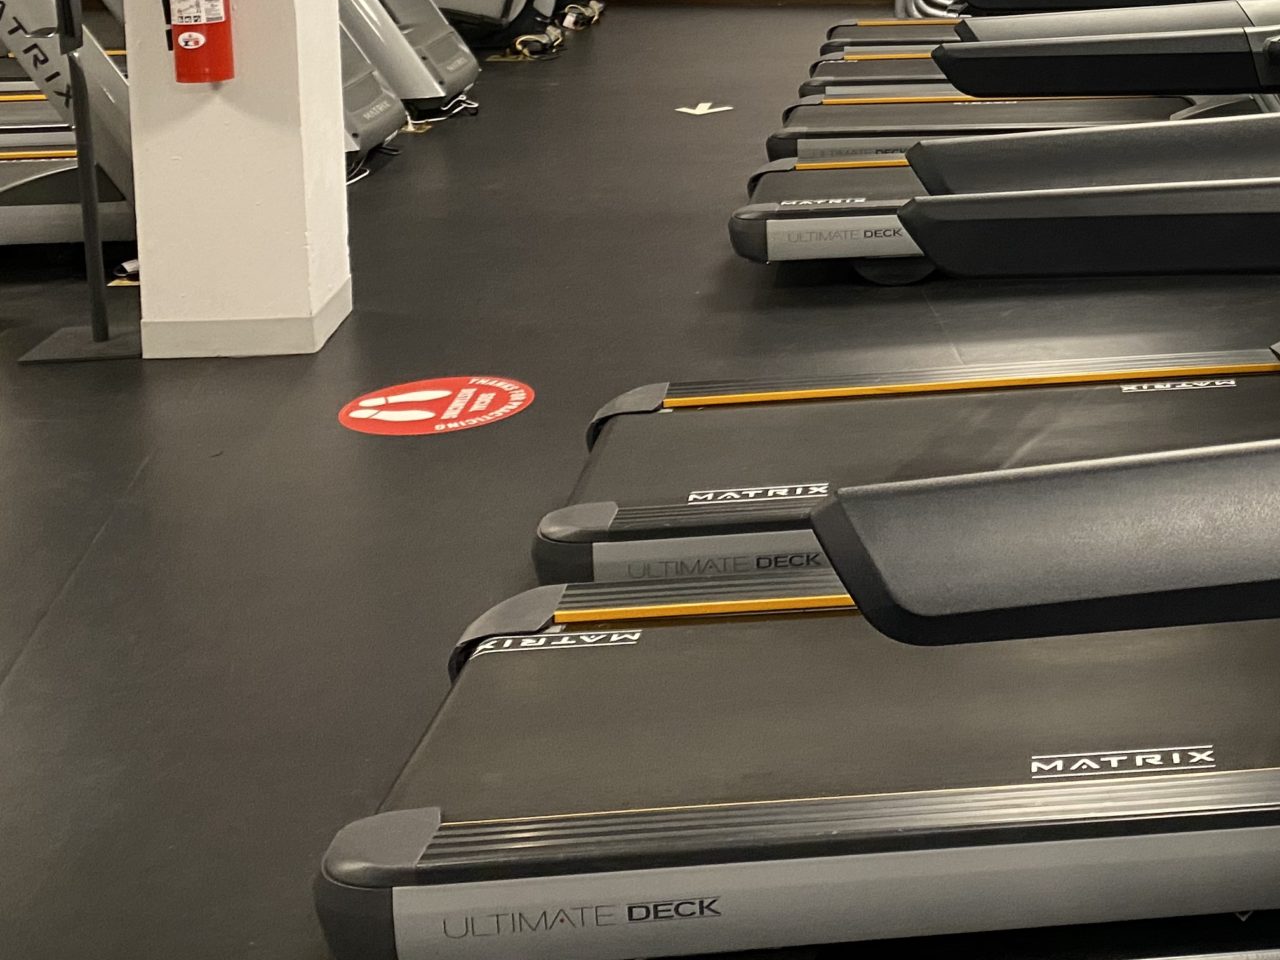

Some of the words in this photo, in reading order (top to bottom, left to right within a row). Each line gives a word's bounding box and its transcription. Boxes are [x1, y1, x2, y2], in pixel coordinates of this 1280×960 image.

[0, 0, 72, 109] TRIX
[787, 228, 860, 242] ULTIMATE
[863, 227, 903, 239] DECK
[687, 484, 829, 503] MATRIX
[627, 555, 750, 578] ULTIMATE
[756, 553, 822, 570] DECK
[1030, 749, 1216, 774] MATRIX
[443, 905, 617, 939] ULTIMATE
[627, 898, 722, 922] DECK
